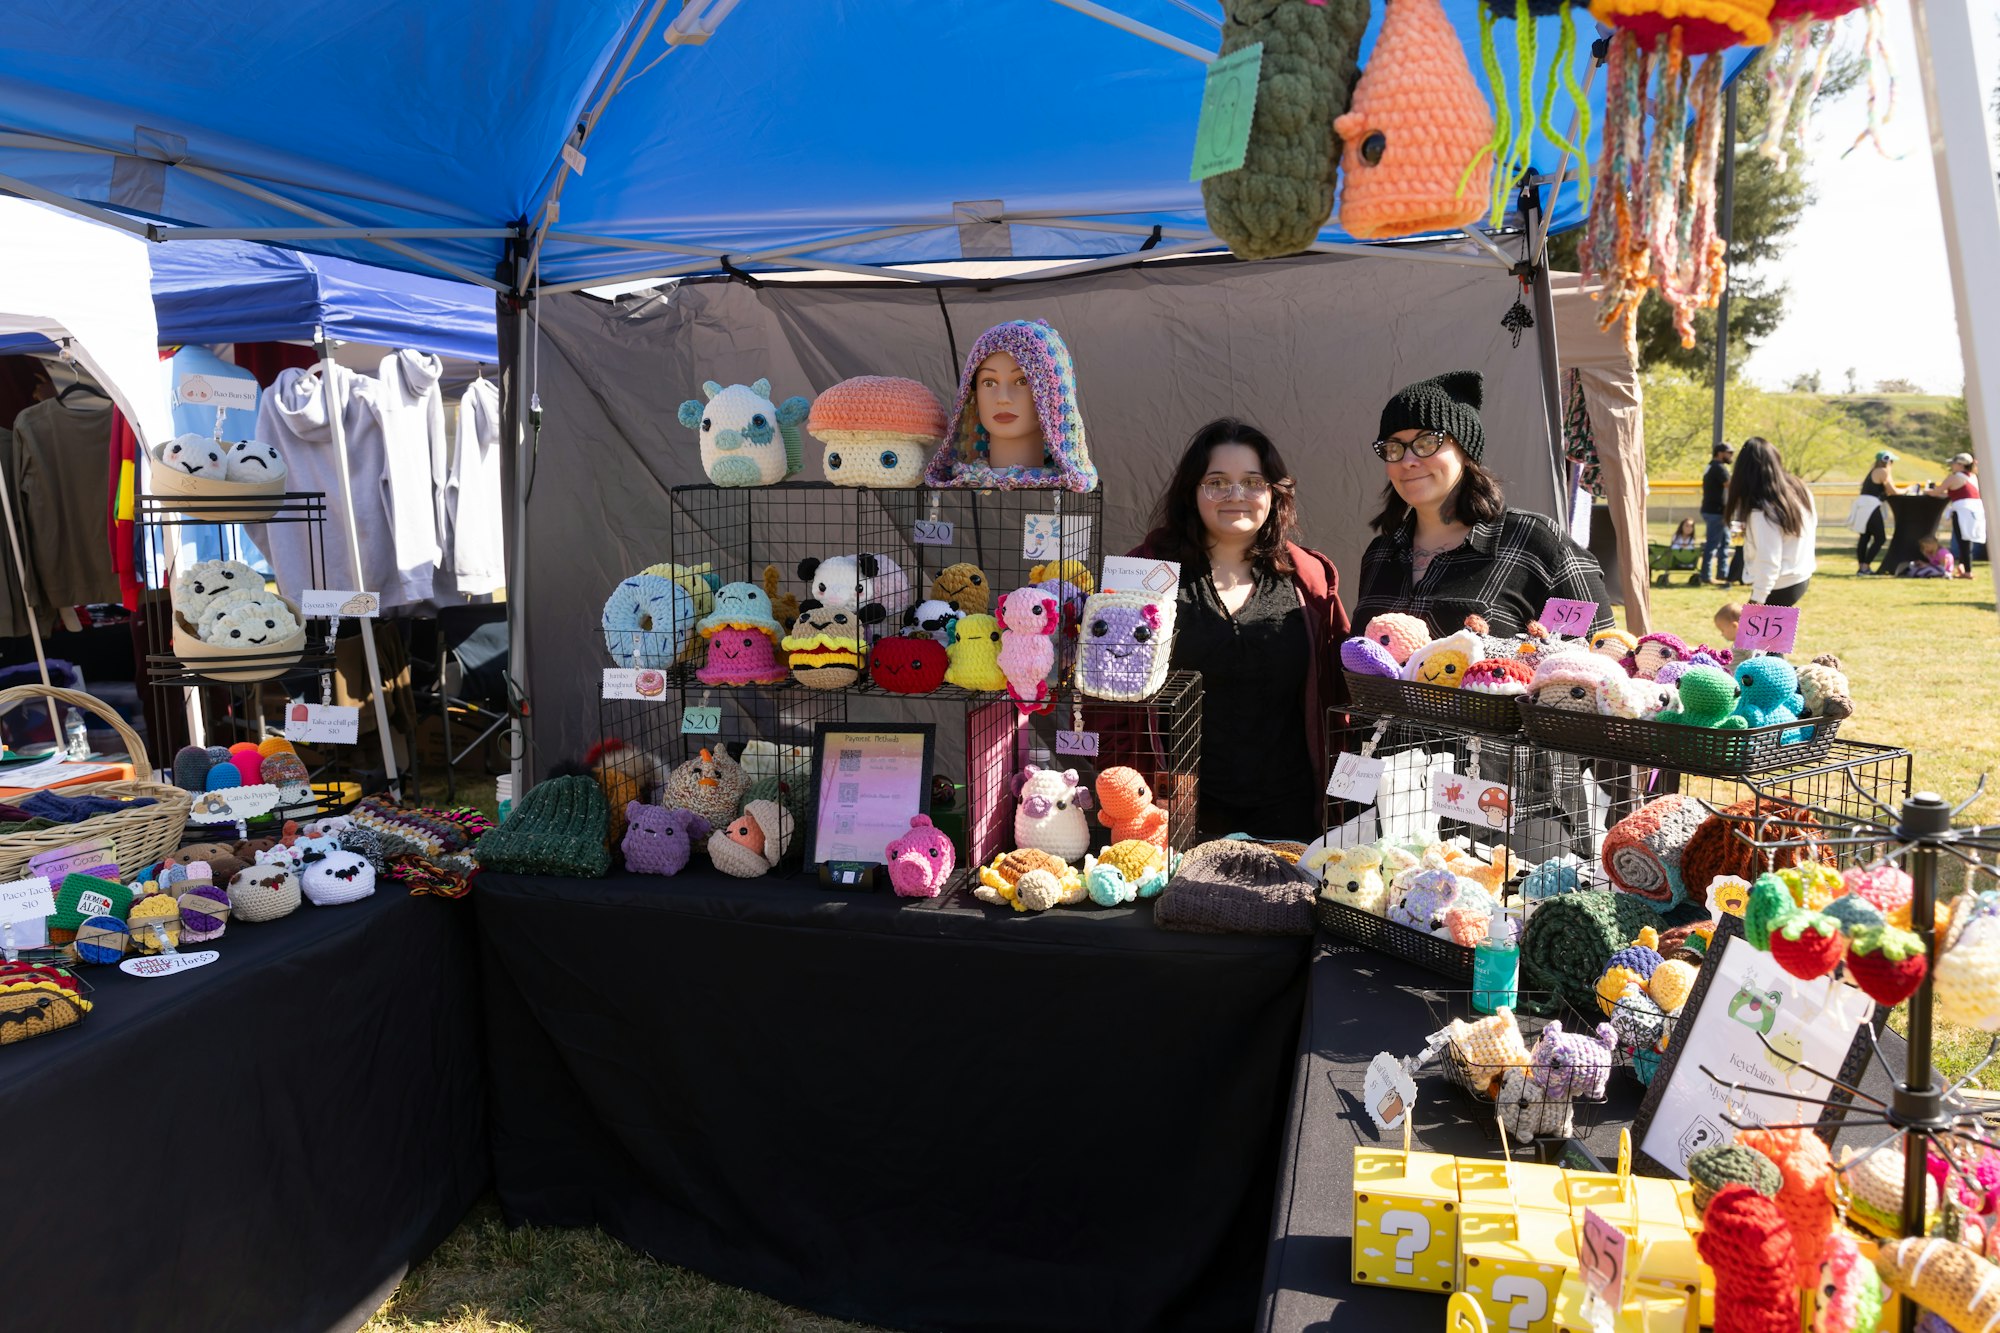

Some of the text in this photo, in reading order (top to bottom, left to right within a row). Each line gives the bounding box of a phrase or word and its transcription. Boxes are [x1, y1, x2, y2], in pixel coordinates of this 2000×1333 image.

[228, 391, 241, 399] Bun
[914, 521, 951, 540] $20
[1104, 566, 1117, 575] Pop
[1117, 567, 1134, 575] Tarts
[1552, 604, 1584, 625] $15
[1746, 612, 1786, 640] $15
[609, 672, 629, 680] Jumbo
[604, 681, 633, 690] Doughnut
[347, 719, 358, 728] pill
[684, 713, 718, 730] $20
[844, 734, 900, 743] Payment Methods
[1058, 731, 1096, 752] $20
[251, 791, 279, 800] Puppies
[1433, 800, 1465, 813] Mushroom
[45, 852, 105, 874] Cup Cozy
[2, 885, 51, 902] Paco Taco
[21, 899, 39, 911] $10
[1729, 1052, 1777, 1086] Keychains
[1706, 1082, 1743, 1110] Mystery
[1581, 1220, 1618, 1285] $5
